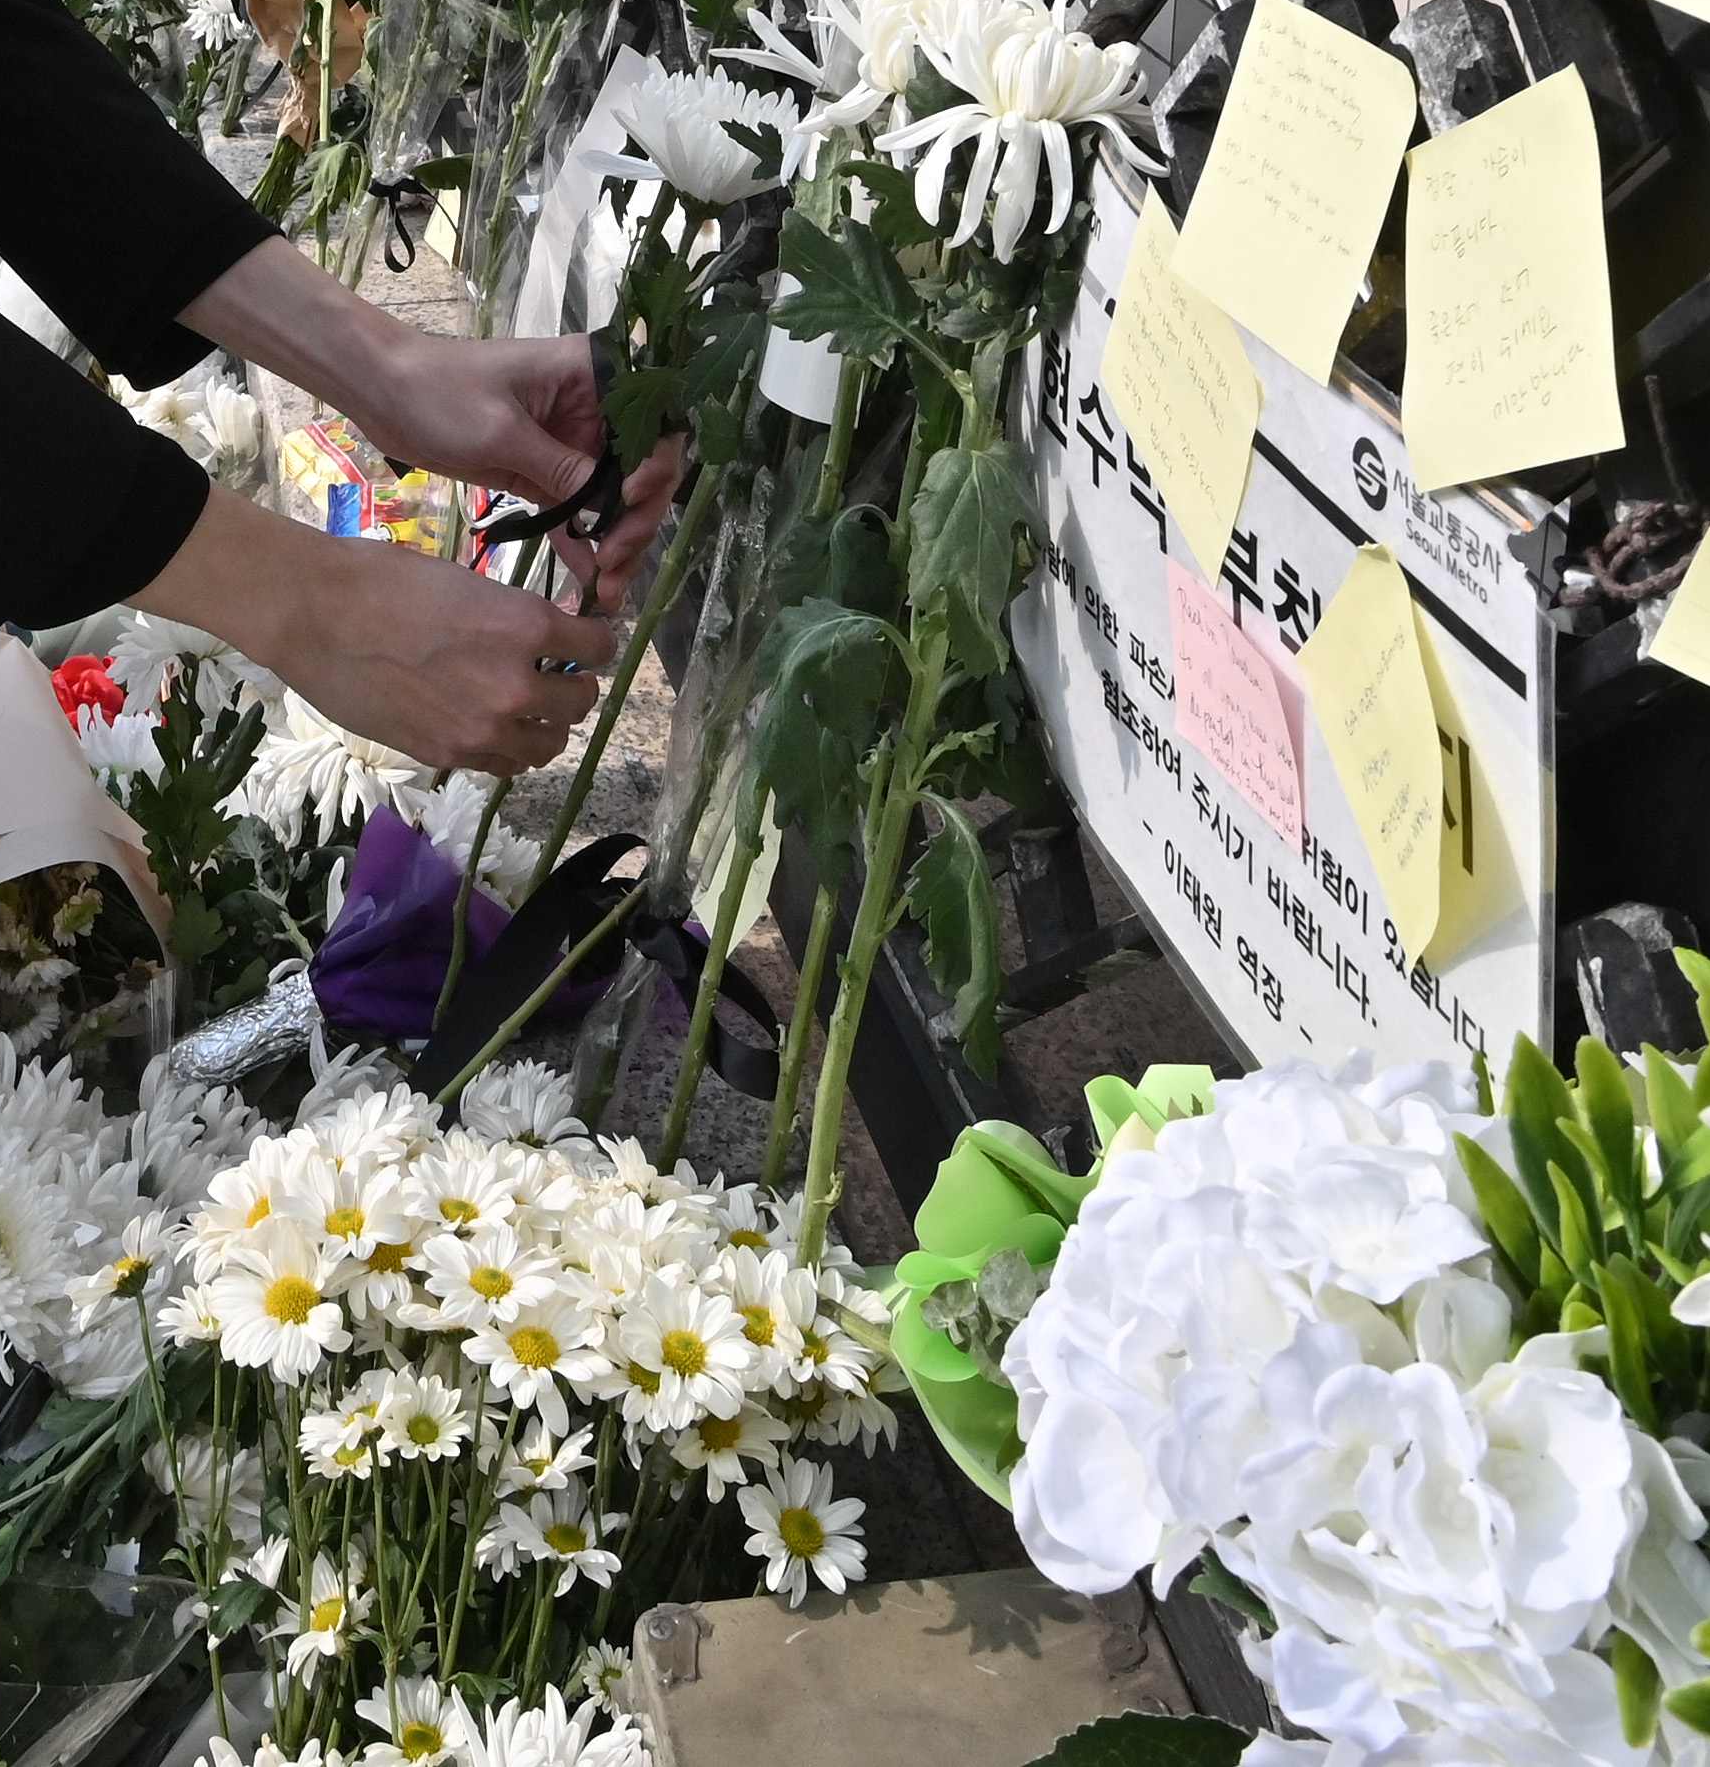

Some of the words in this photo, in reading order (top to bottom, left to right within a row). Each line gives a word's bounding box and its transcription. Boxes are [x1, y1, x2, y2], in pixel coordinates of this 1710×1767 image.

[1392, 469, 1503, 586] 서울교통공사
[1405, 517, 1442, 565] Seoul
[1444, 556, 1489, 604] Metro
[1084, 583, 1119, 650] 의한
[1098, 667, 1182, 793] 협조하여
[1191, 771, 1255, 886] 주시기
[1266, 866, 1379, 1030] 바랍니다.
[1162, 837, 1224, 951] 이태원
[1235, 934, 1285, 1024] 역장
